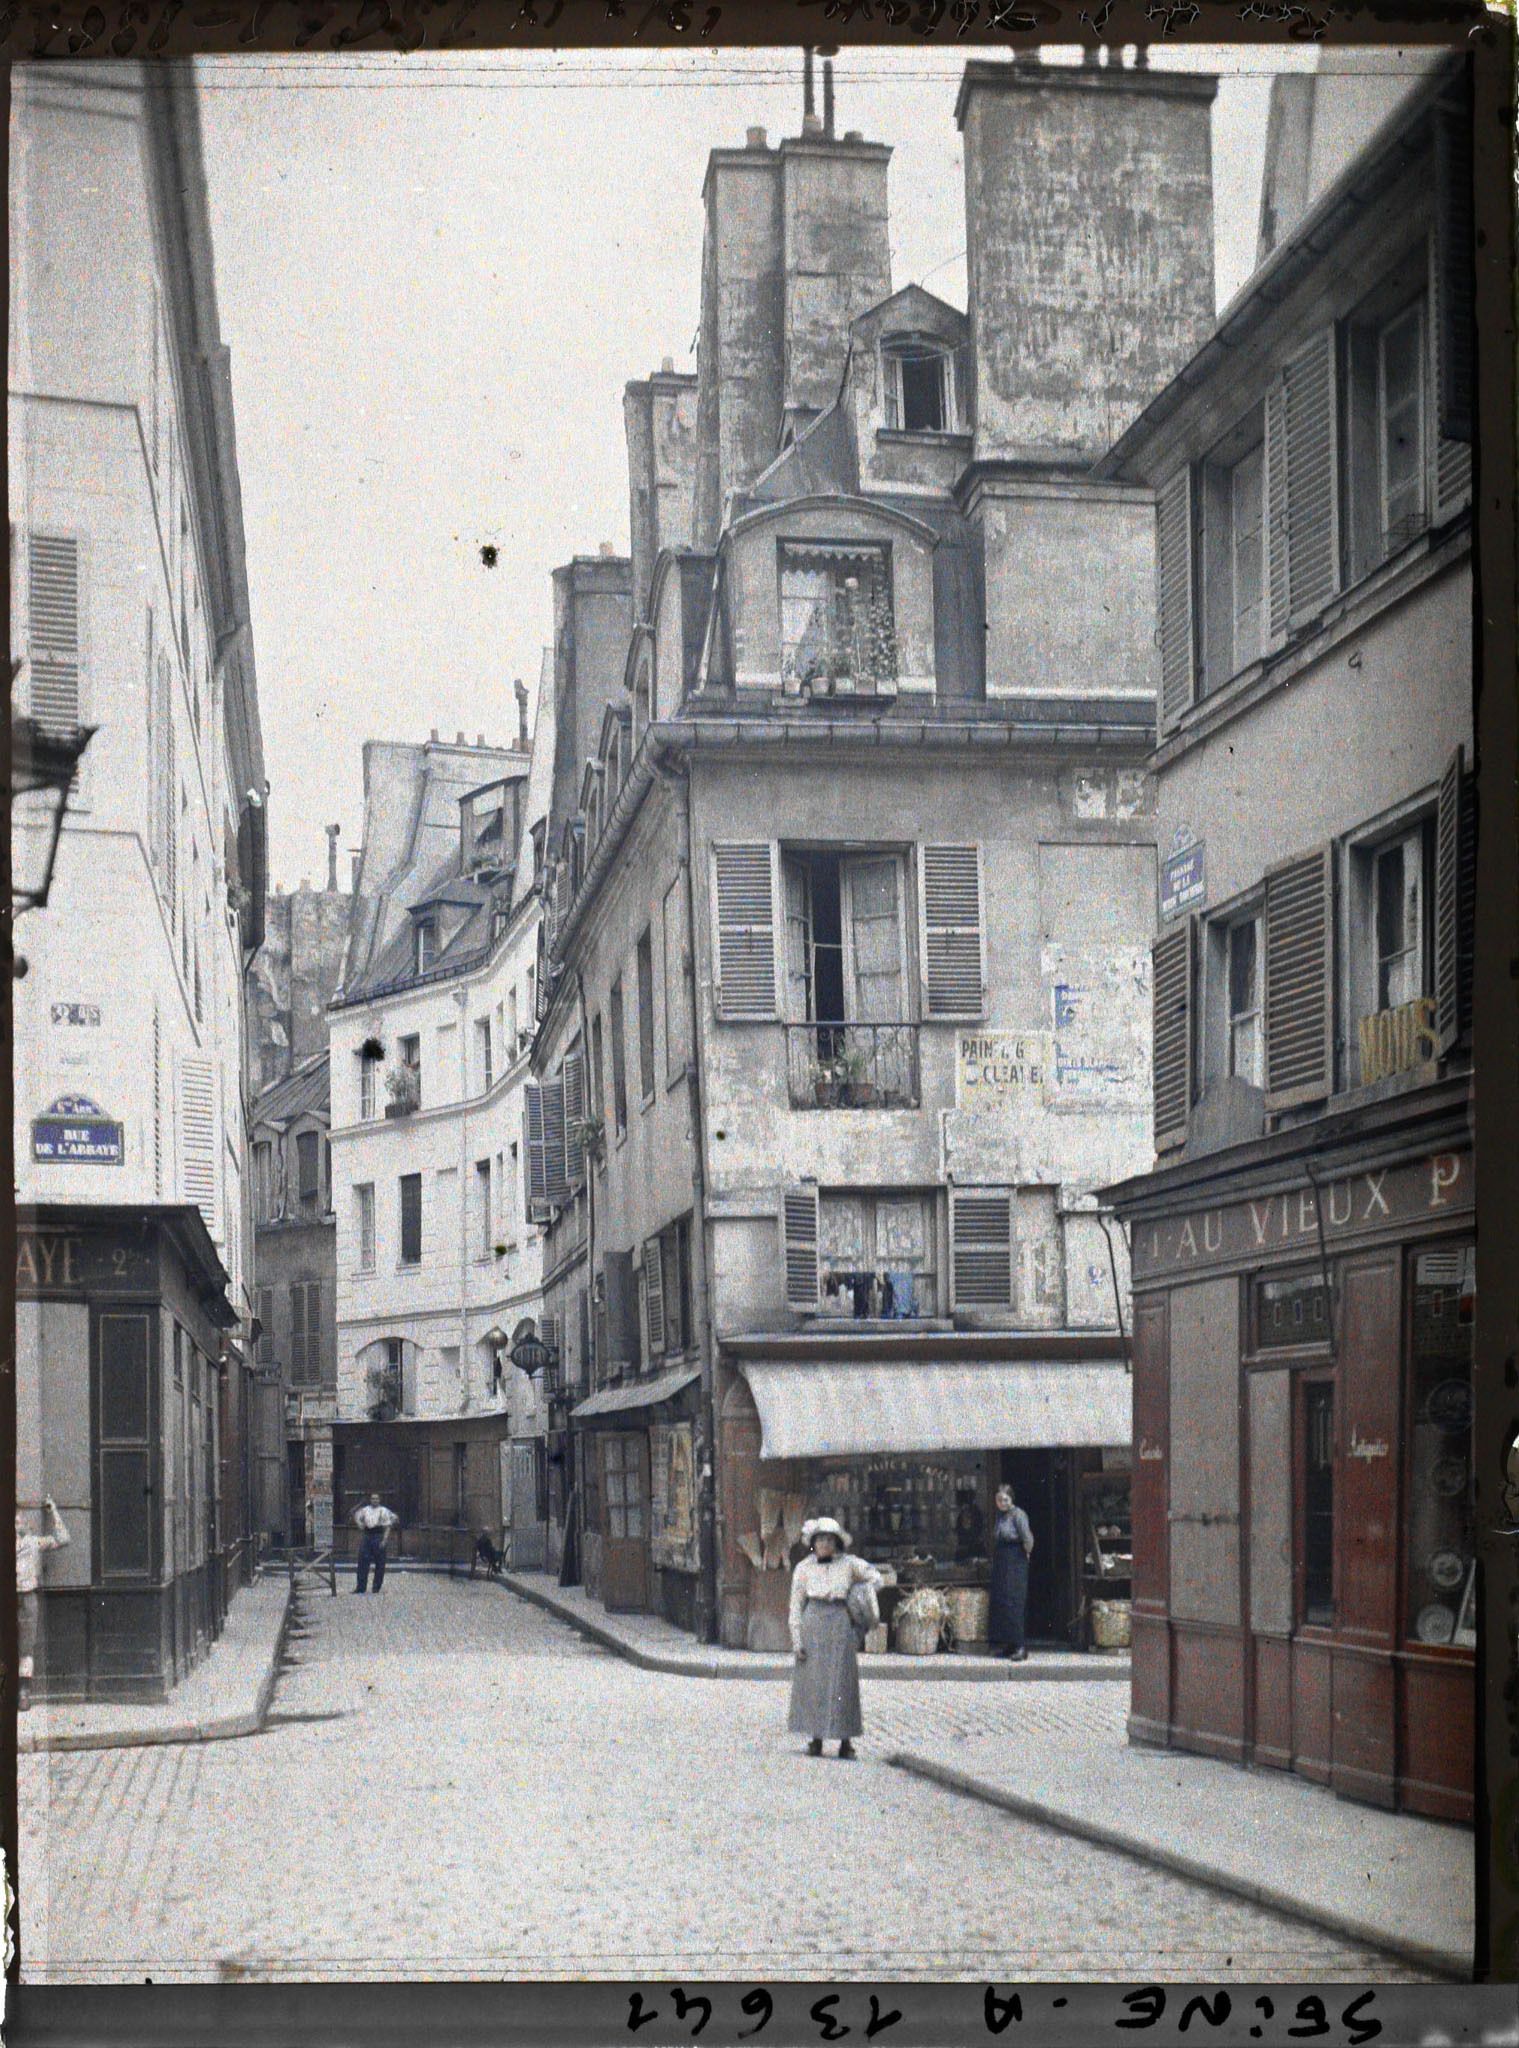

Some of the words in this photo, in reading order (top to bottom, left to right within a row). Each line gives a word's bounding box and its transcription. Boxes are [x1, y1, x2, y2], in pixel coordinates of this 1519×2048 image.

[63, 1129, 90, 1142] RUE
[36, 1143, 54, 1155] DE
[57, 1142, 119, 1157] L'ABBAYE
[1175, 1210, 1223, 1259] AU
[1248, 1171, 1390, 1244] VIEUX
